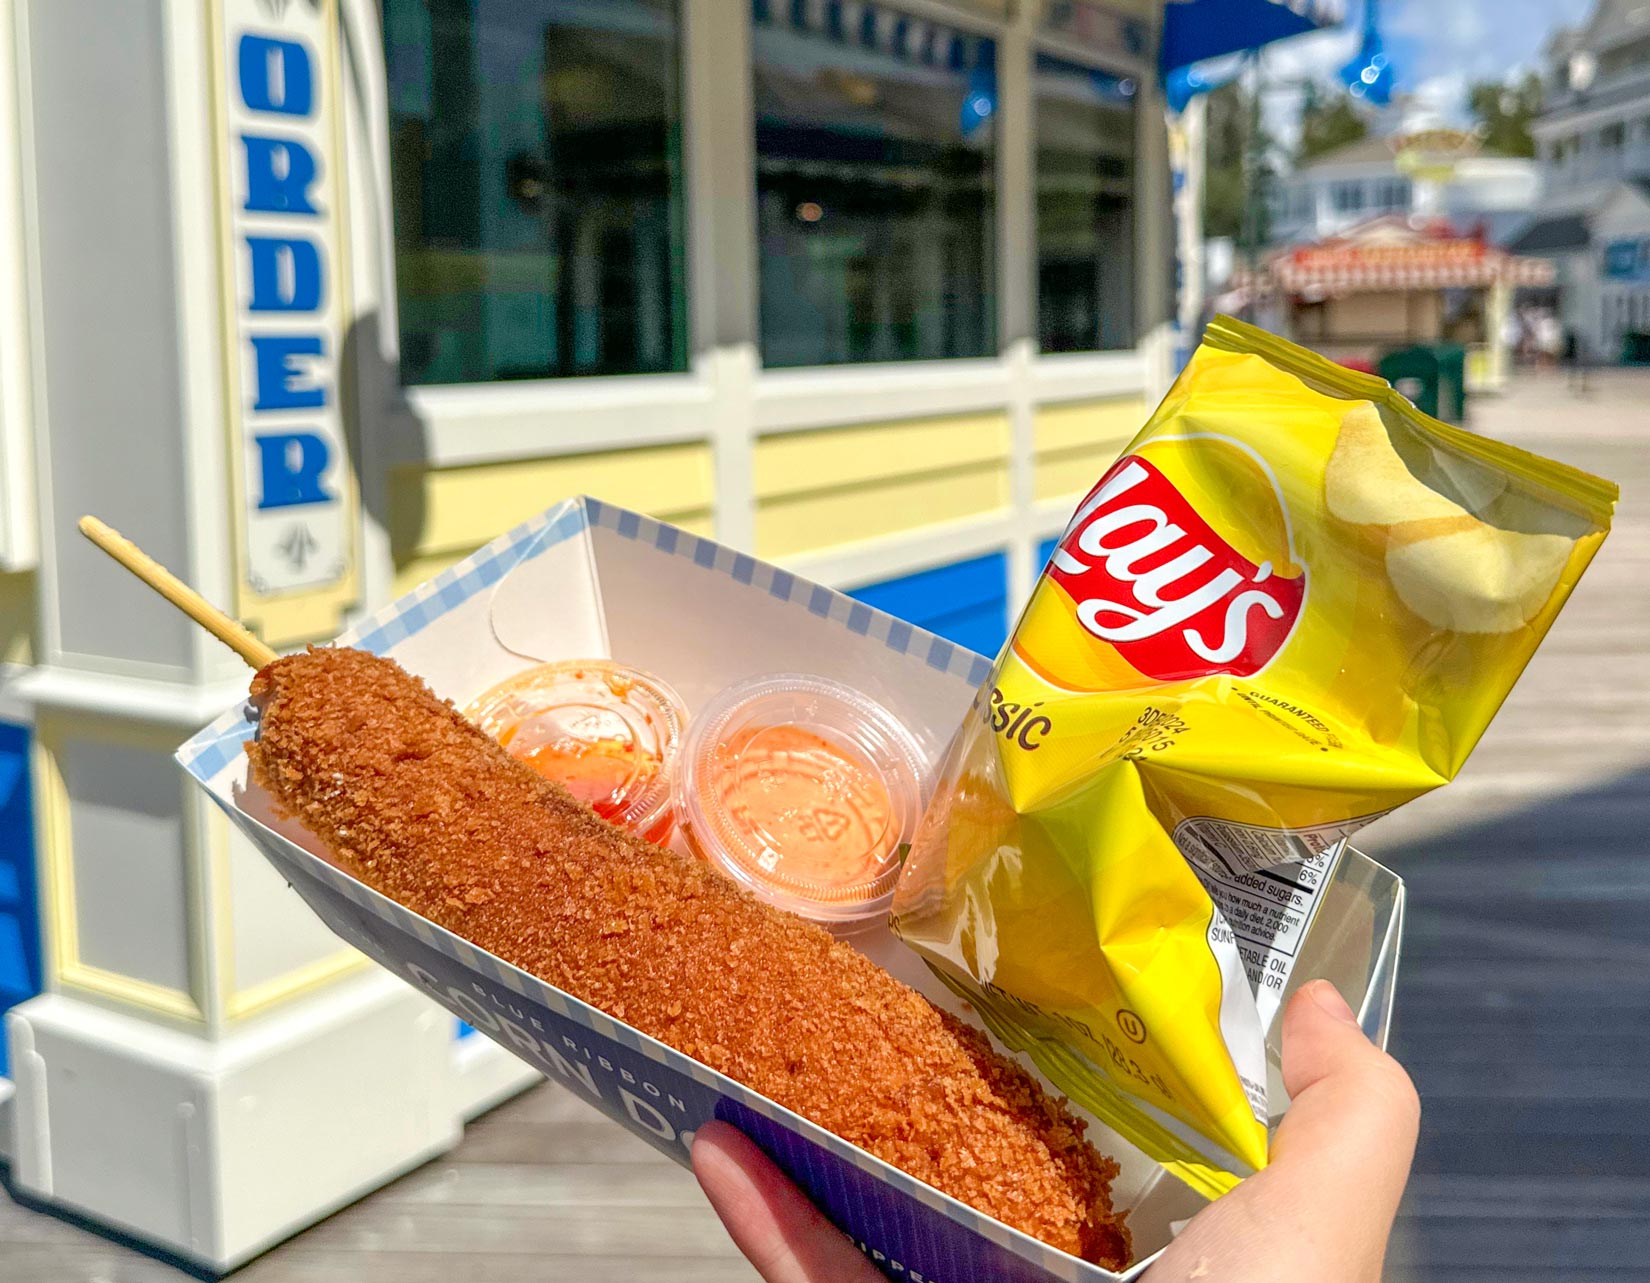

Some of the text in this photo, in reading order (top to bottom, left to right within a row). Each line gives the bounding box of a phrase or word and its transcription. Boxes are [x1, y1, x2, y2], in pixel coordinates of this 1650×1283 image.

[239, 34, 337, 510] ORDER
[1050, 460, 1285, 664] Lay's
[1249, 691, 1330, 733] GUARANTEED
[1234, 873, 1267, 892] added
[1267, 884, 1304, 907] sugars.
[1299, 869, 1317, 885] 6%
[1241, 897, 1262, 913] much
[1262, 906, 1268, 915] a
[1269, 908, 1300, 927] nutrient
[1265, 918, 1289, 934] 2,000
[1247, 967, 1283, 990] AND/OR
[1269, 958, 1287, 975] OIL
[407, 961, 696, 1149] CORN D
[471, 982, 688, 1113] BLUE RIBBON
[844, 1233, 936, 1283] IPPE
